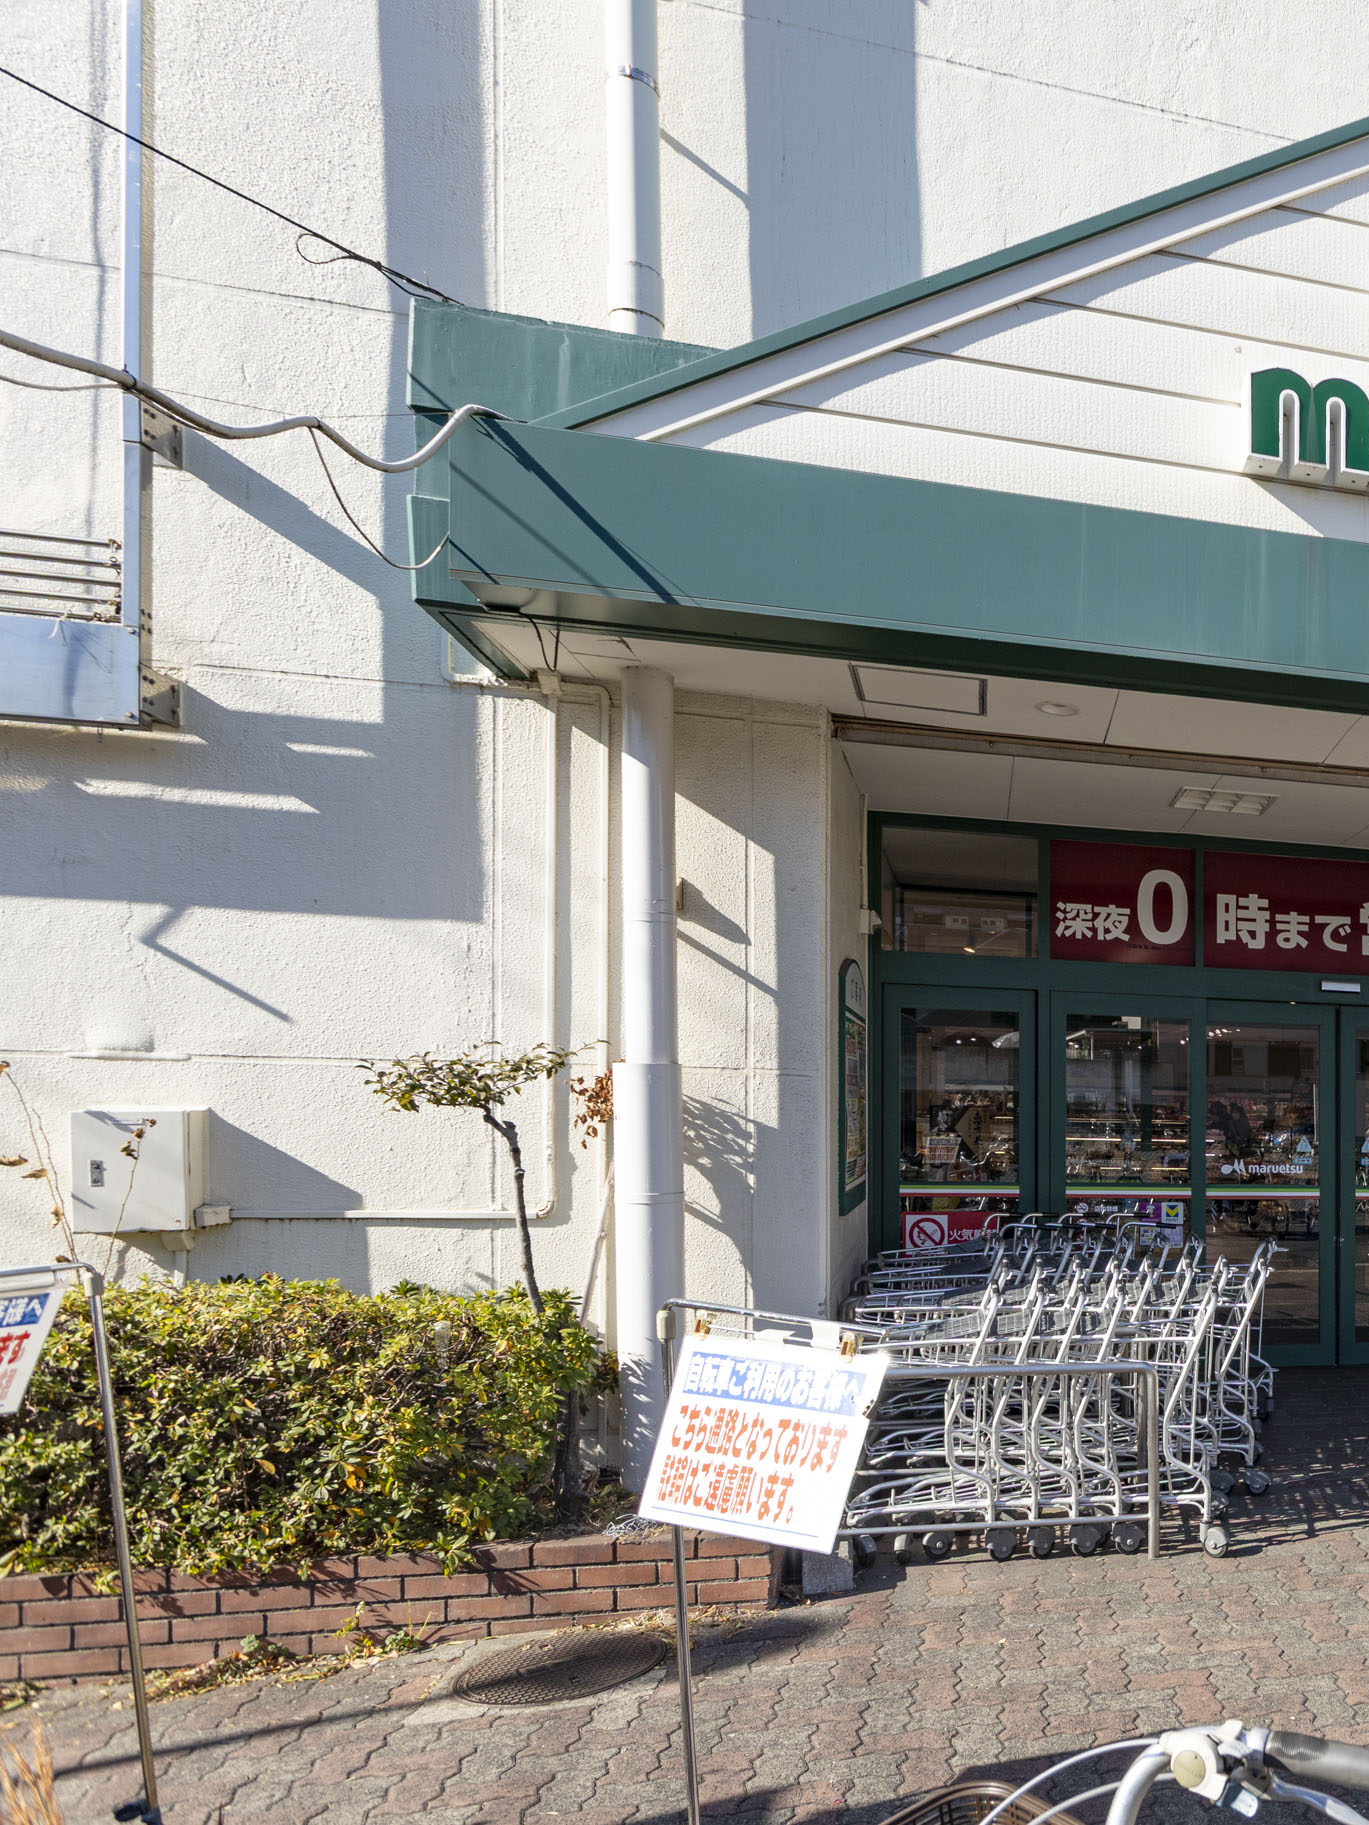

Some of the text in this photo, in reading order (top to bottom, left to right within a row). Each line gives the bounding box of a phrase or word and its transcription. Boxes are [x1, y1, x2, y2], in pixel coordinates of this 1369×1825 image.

[1248, 1163, 1304, 1174] maruetsu
[684, 1353, 864, 1411] 自転車ご利用のお客様へ
[671, 1403, 849, 1473] こちら通路となっております
[657, 1454, 795, 1525] 駐輪はご遠慮願います。
